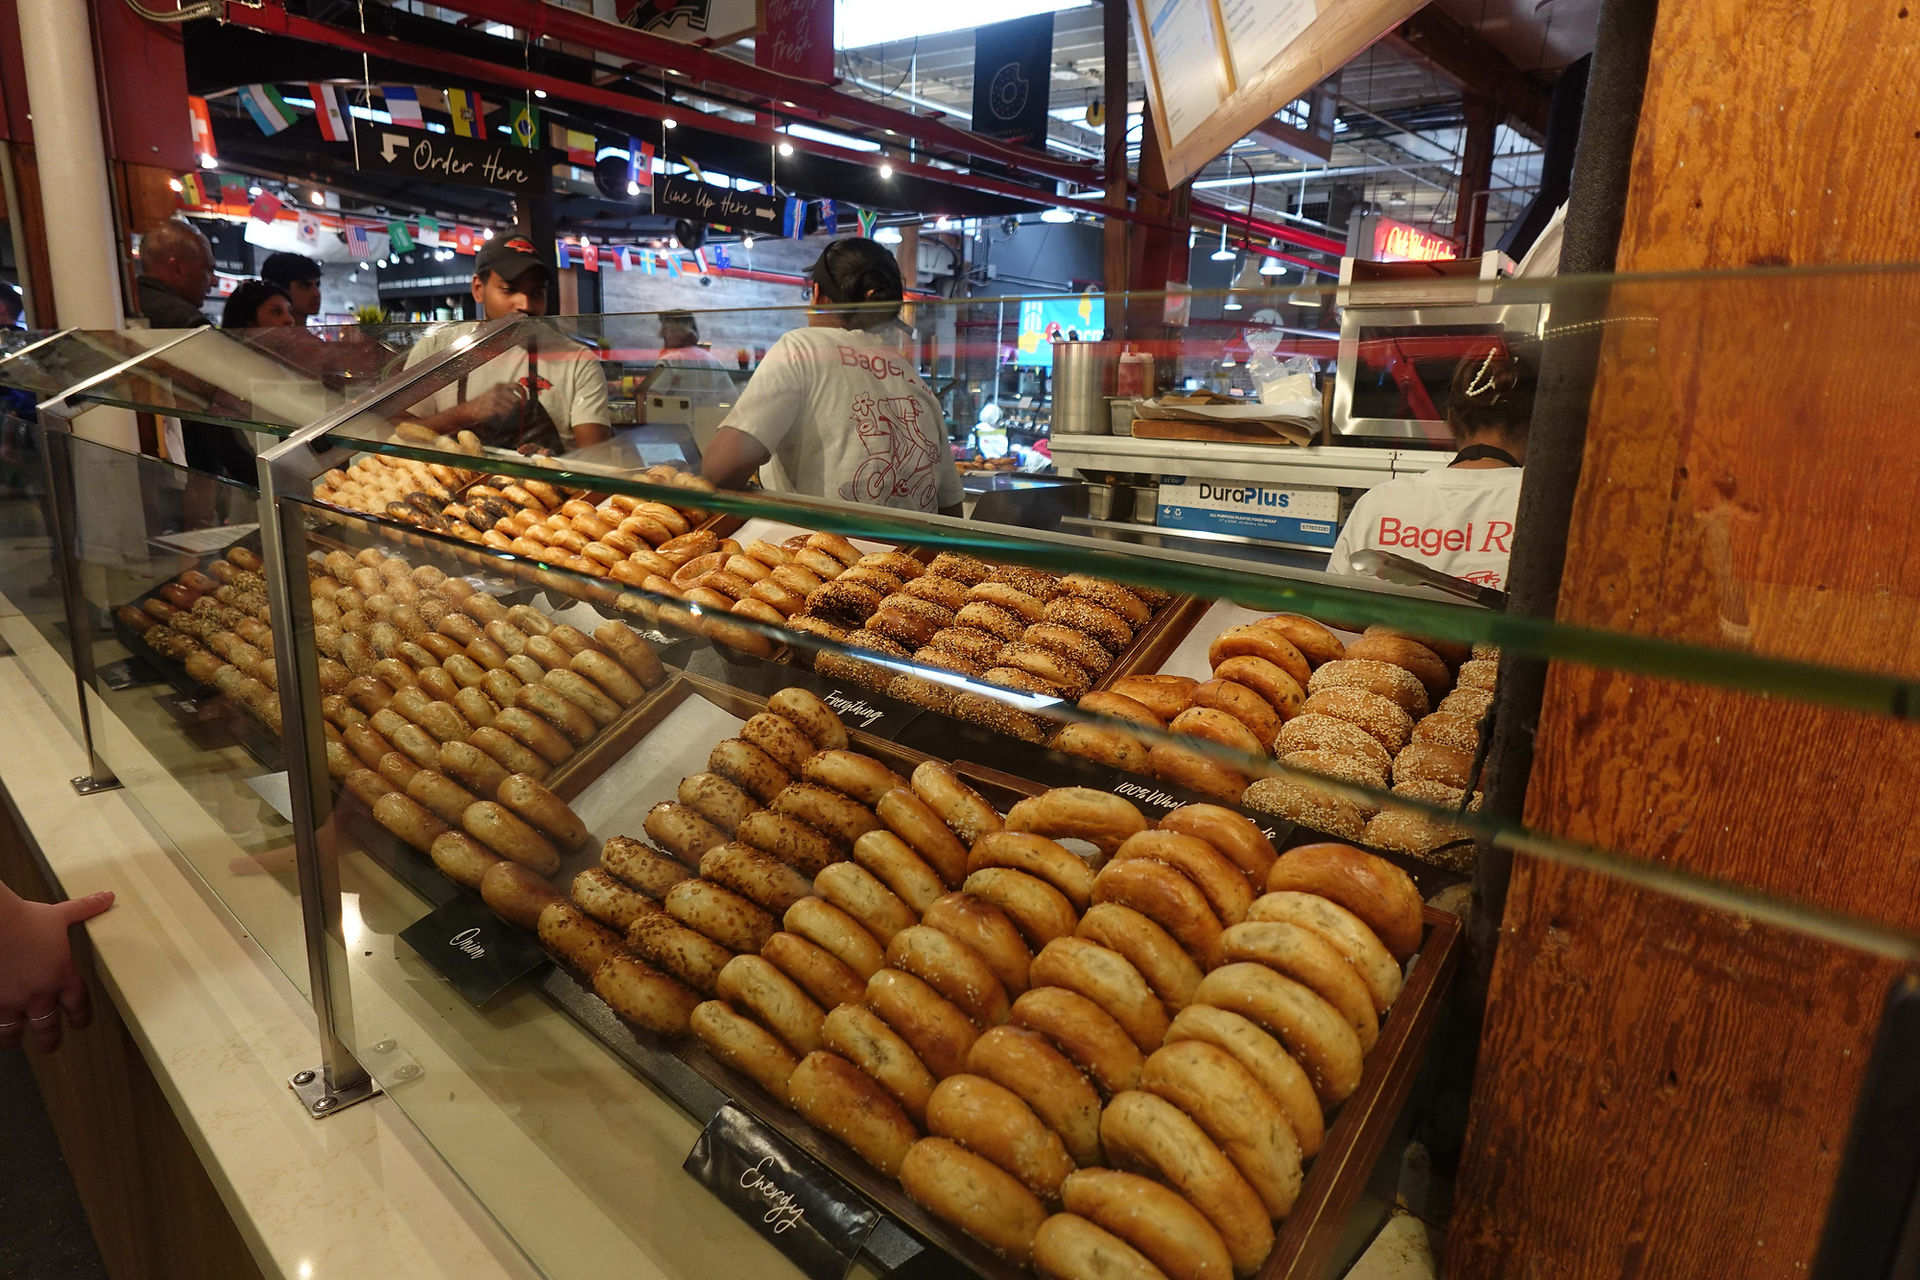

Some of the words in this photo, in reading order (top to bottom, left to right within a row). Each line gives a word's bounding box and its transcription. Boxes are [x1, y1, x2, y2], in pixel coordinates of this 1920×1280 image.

[413, 139, 474, 175] Order
[482, 148, 529, 184] Here
[663, 180, 692, 204] Line
[696, 188, 715, 217] Up
[721, 191, 751, 216] Here
[837, 345, 904, 380] Bage
[1200, 483, 1290, 508] DuraPlus
[1379, 517, 1473, 556] Bagel
[823, 689, 884, 728] Everything
[1113, 781, 1151, 799] 100%
[1144, 789, 1187, 811] Whol
[449, 927, 486, 960] Onion
[740, 1155, 805, 1234] Energy
